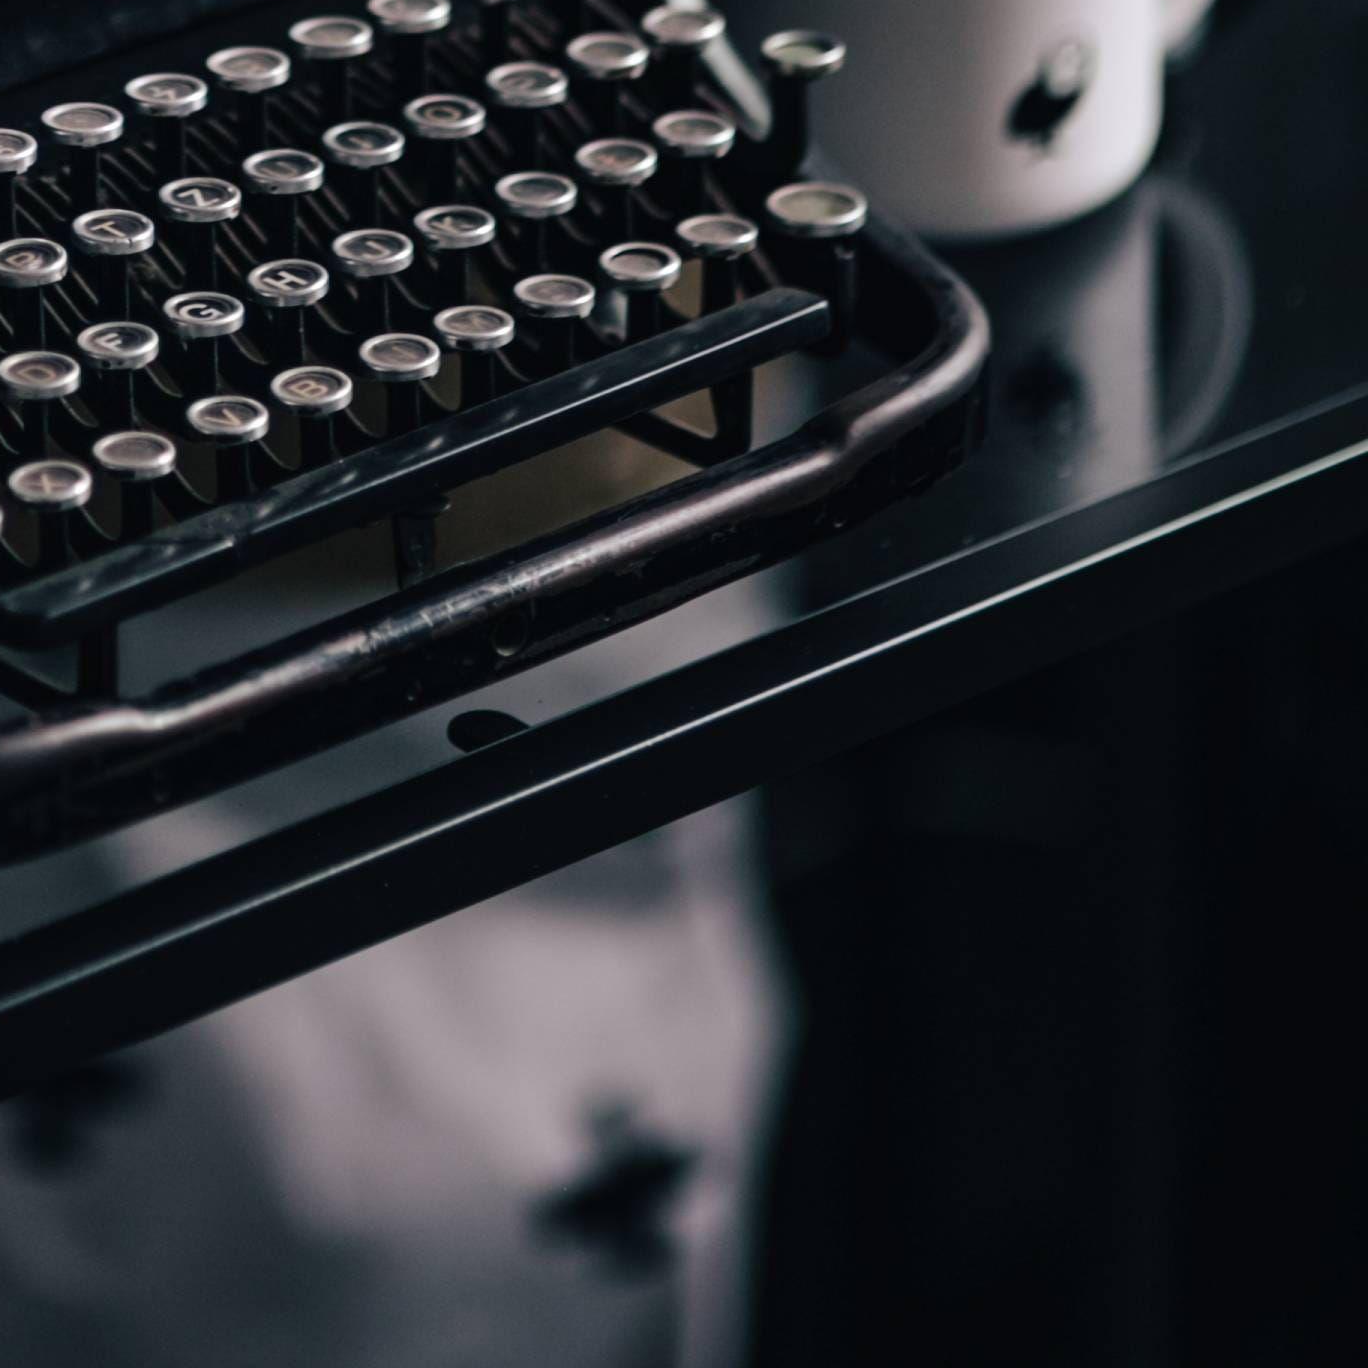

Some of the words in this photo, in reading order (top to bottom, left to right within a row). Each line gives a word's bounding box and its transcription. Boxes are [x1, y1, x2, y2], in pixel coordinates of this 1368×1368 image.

[176, 188, 221, 207] Z
[90, 220, 126, 238] T
[262, 270, 309, 292] H
[179, 302, 225, 322] G
[93, 331, 124, 353] F
[289, 379, 329, 399] B
